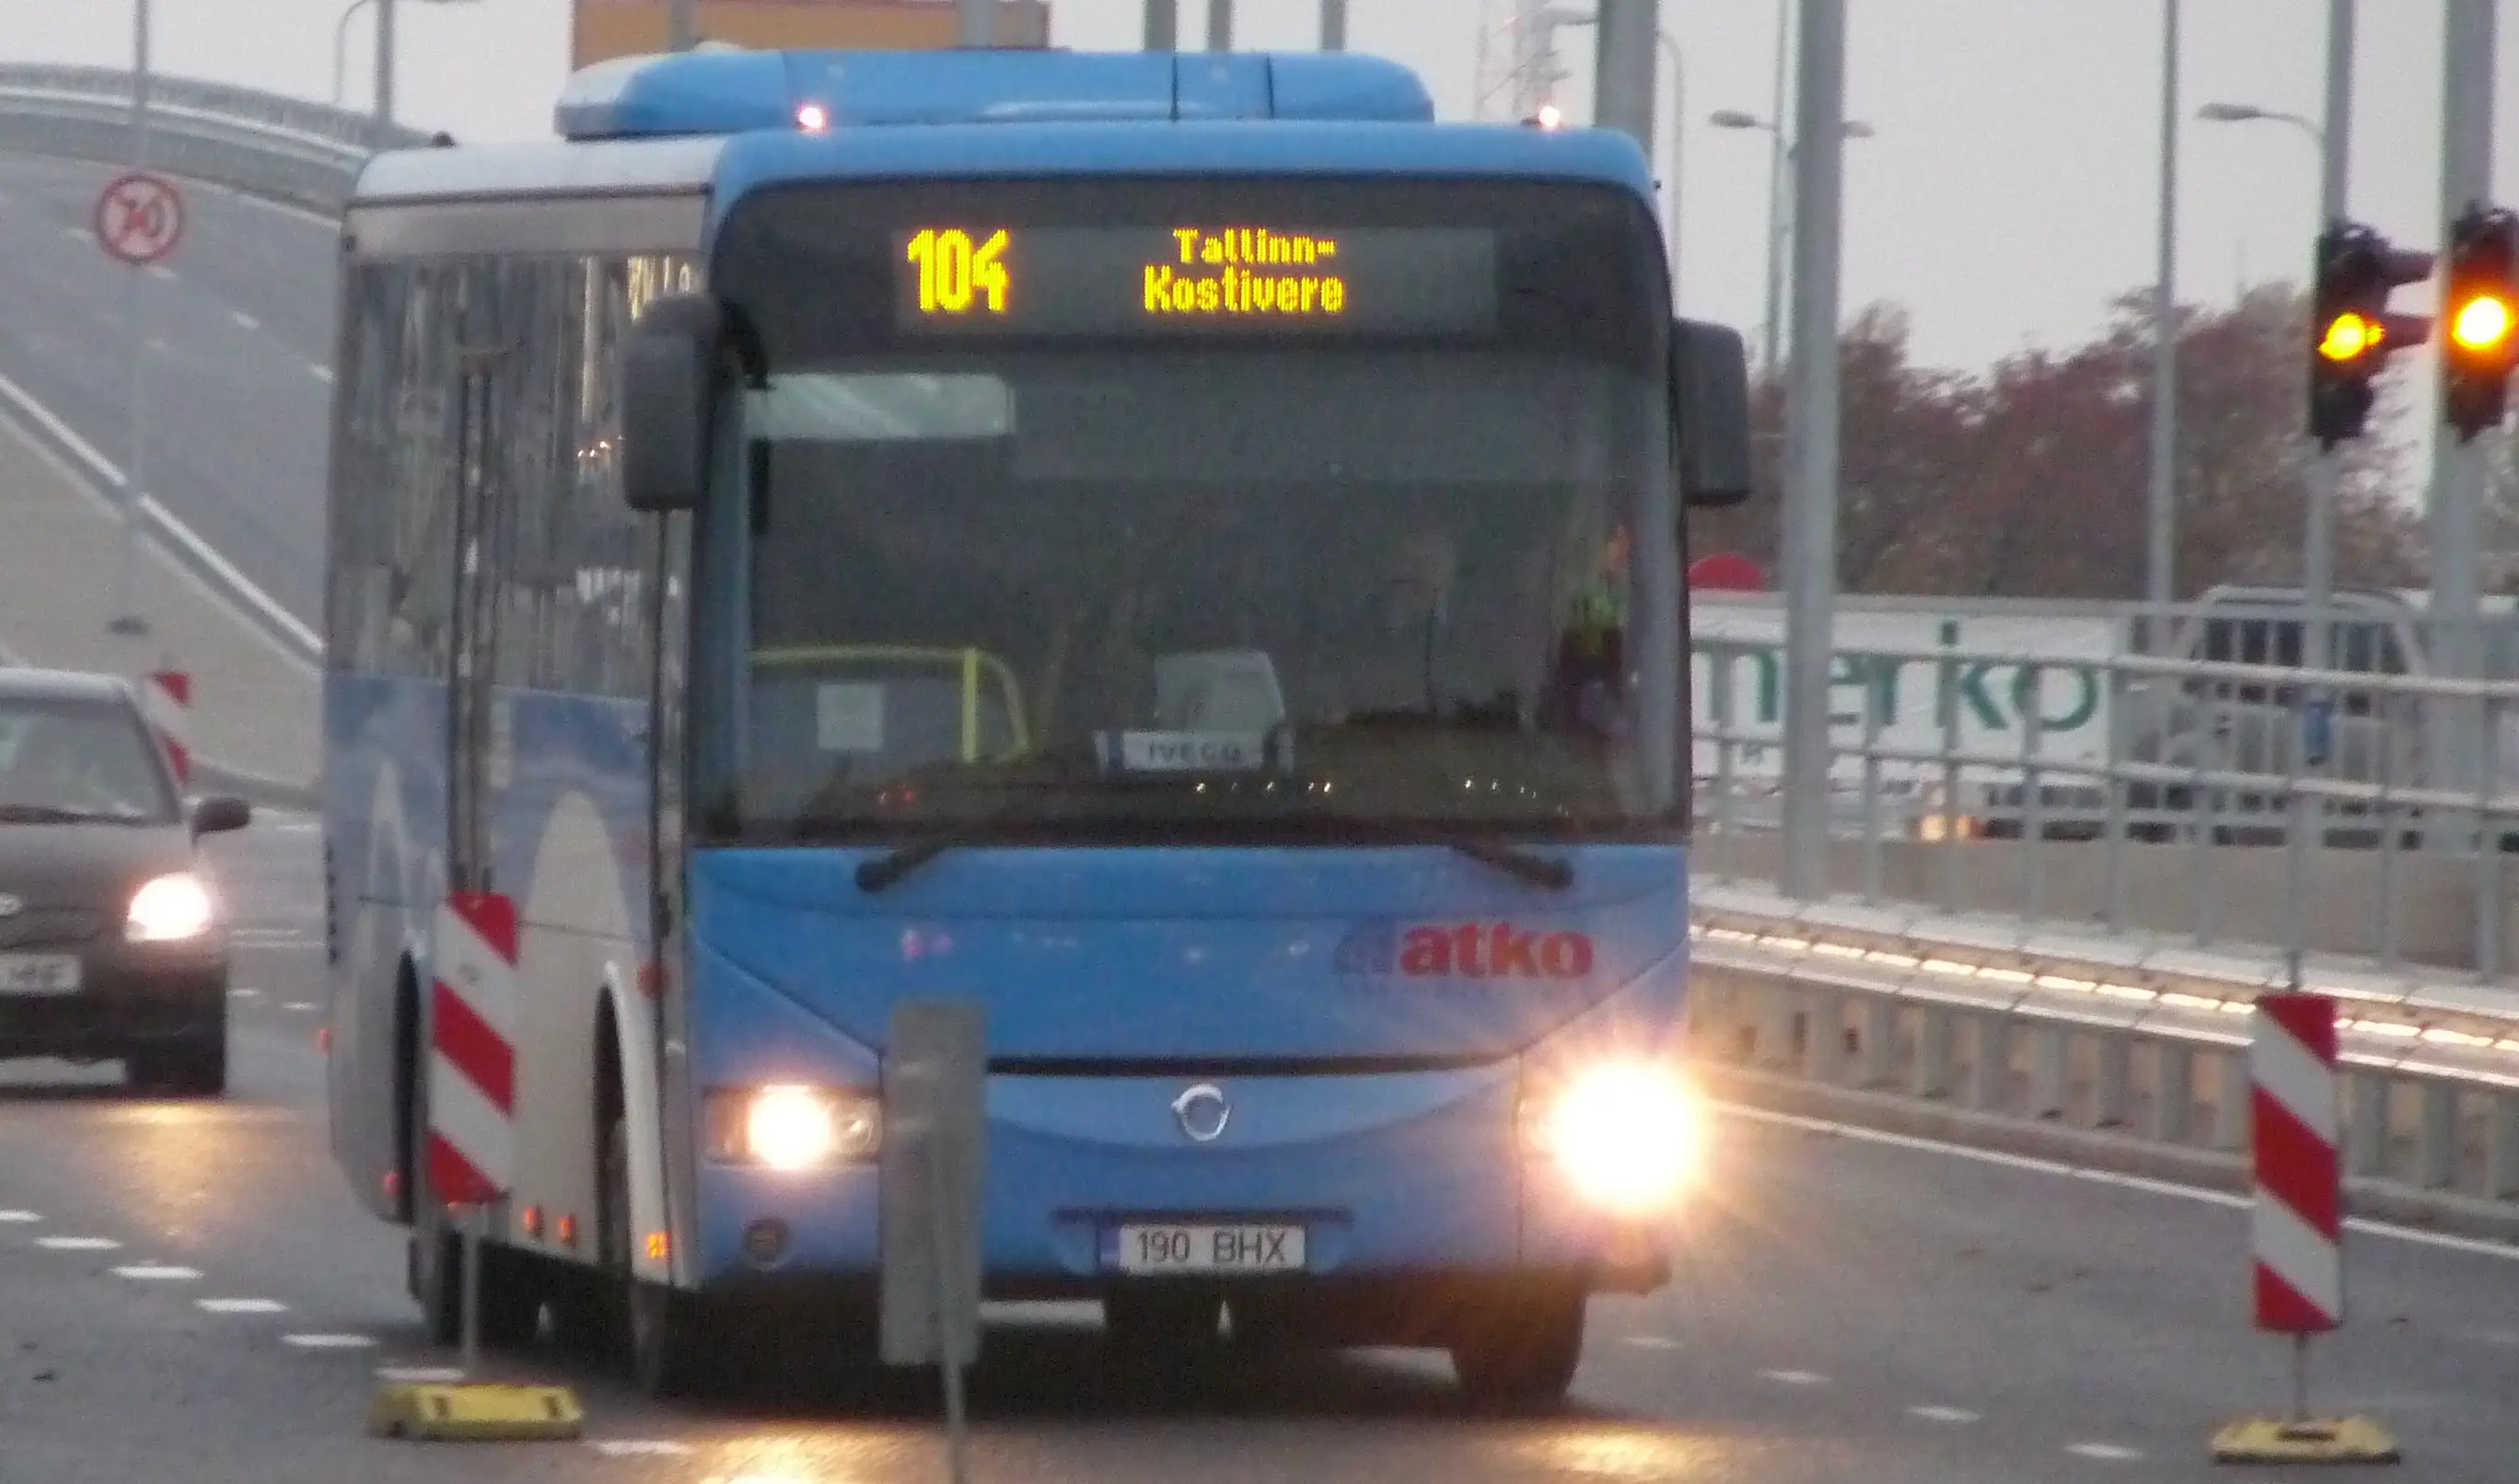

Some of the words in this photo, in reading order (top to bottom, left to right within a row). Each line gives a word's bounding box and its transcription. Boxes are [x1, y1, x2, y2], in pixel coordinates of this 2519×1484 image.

[907, 227, 1009, 312] 104
[1172, 227, 1337, 264] Tallinn-
[1142, 263, 1345, 312] Kostivere
[1399, 921, 1594, 980] atko
[1136, 1228, 1190, 1264] 190
[1213, 1228, 1286, 1265] BHX
